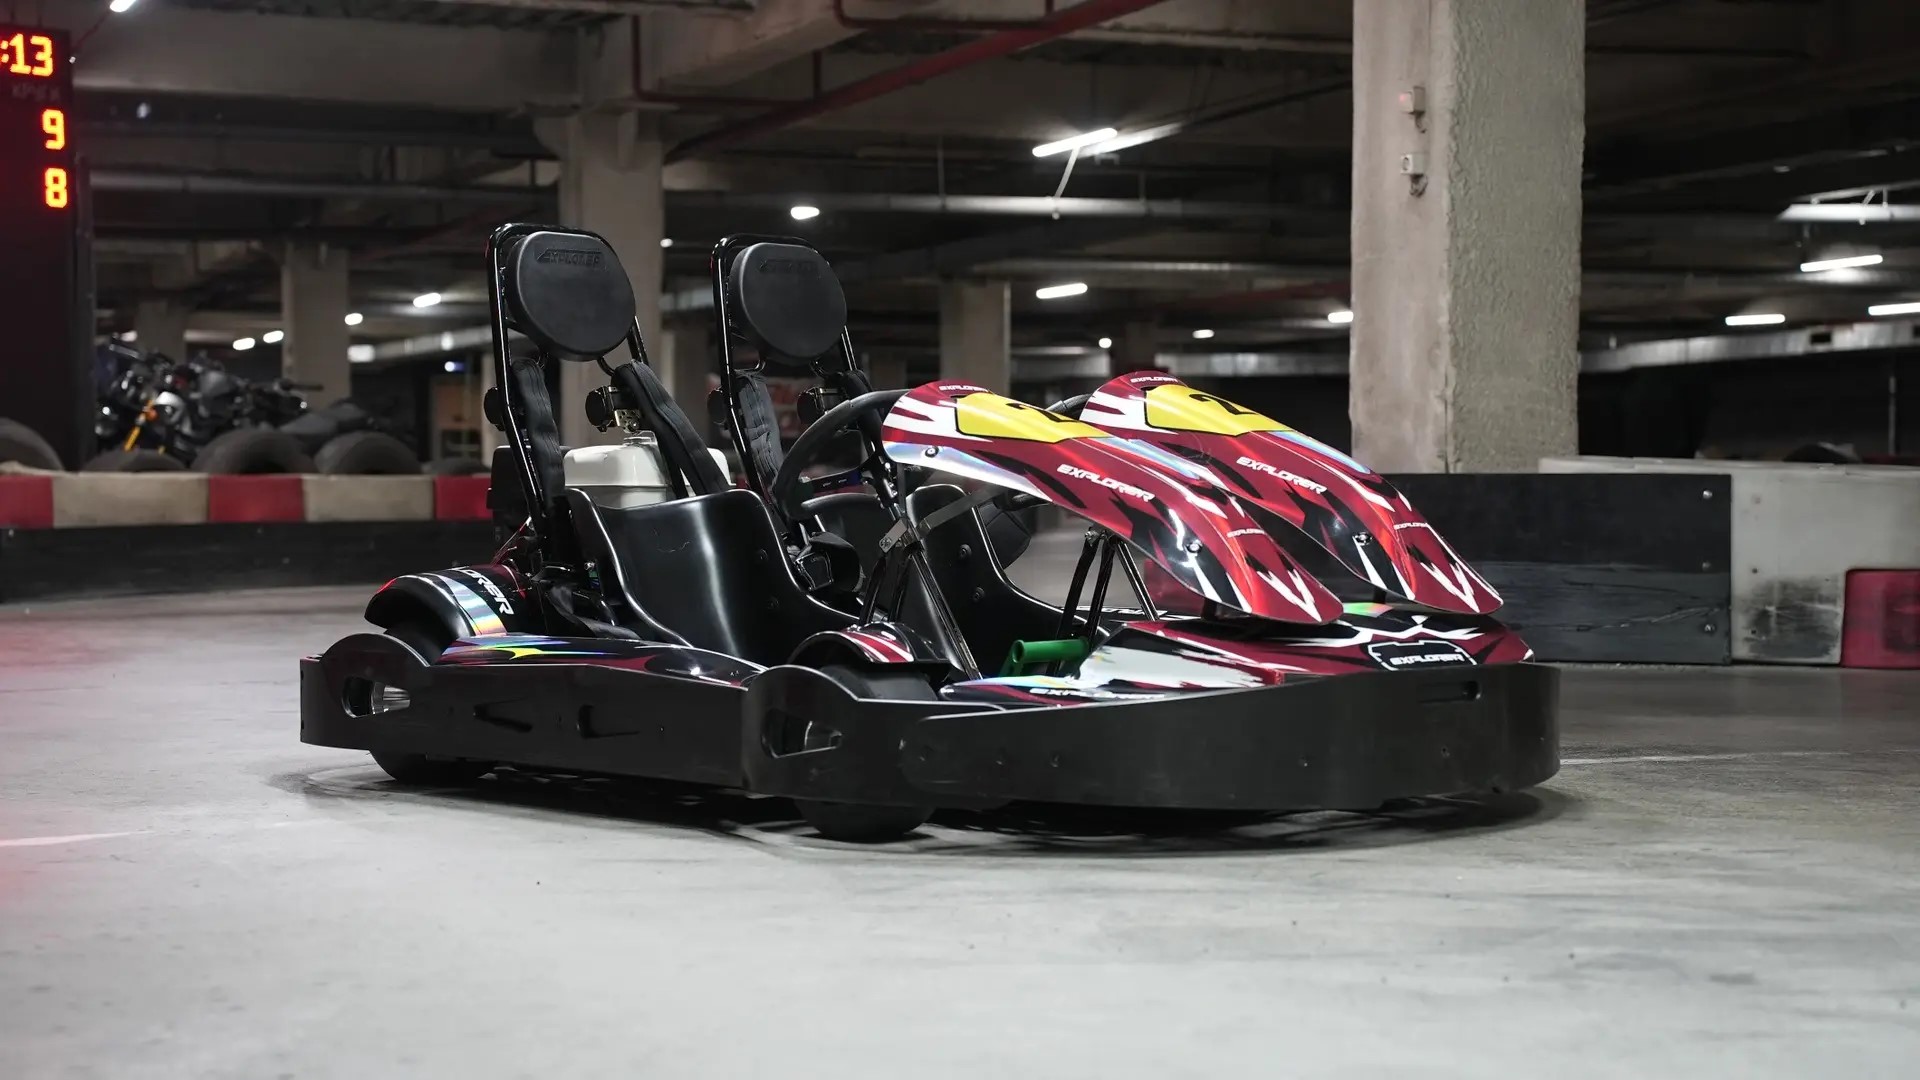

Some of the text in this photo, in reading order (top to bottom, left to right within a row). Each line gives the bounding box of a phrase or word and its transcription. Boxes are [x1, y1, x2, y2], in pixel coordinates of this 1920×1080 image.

[42, 108, 66, 150] 9
[44, 167, 68, 208] 8
[1056, 463, 1155, 503] EXPLORER
[1236, 456, 1328, 495] EXPLORER
[1389, 653, 1466, 666] EXPLORER
